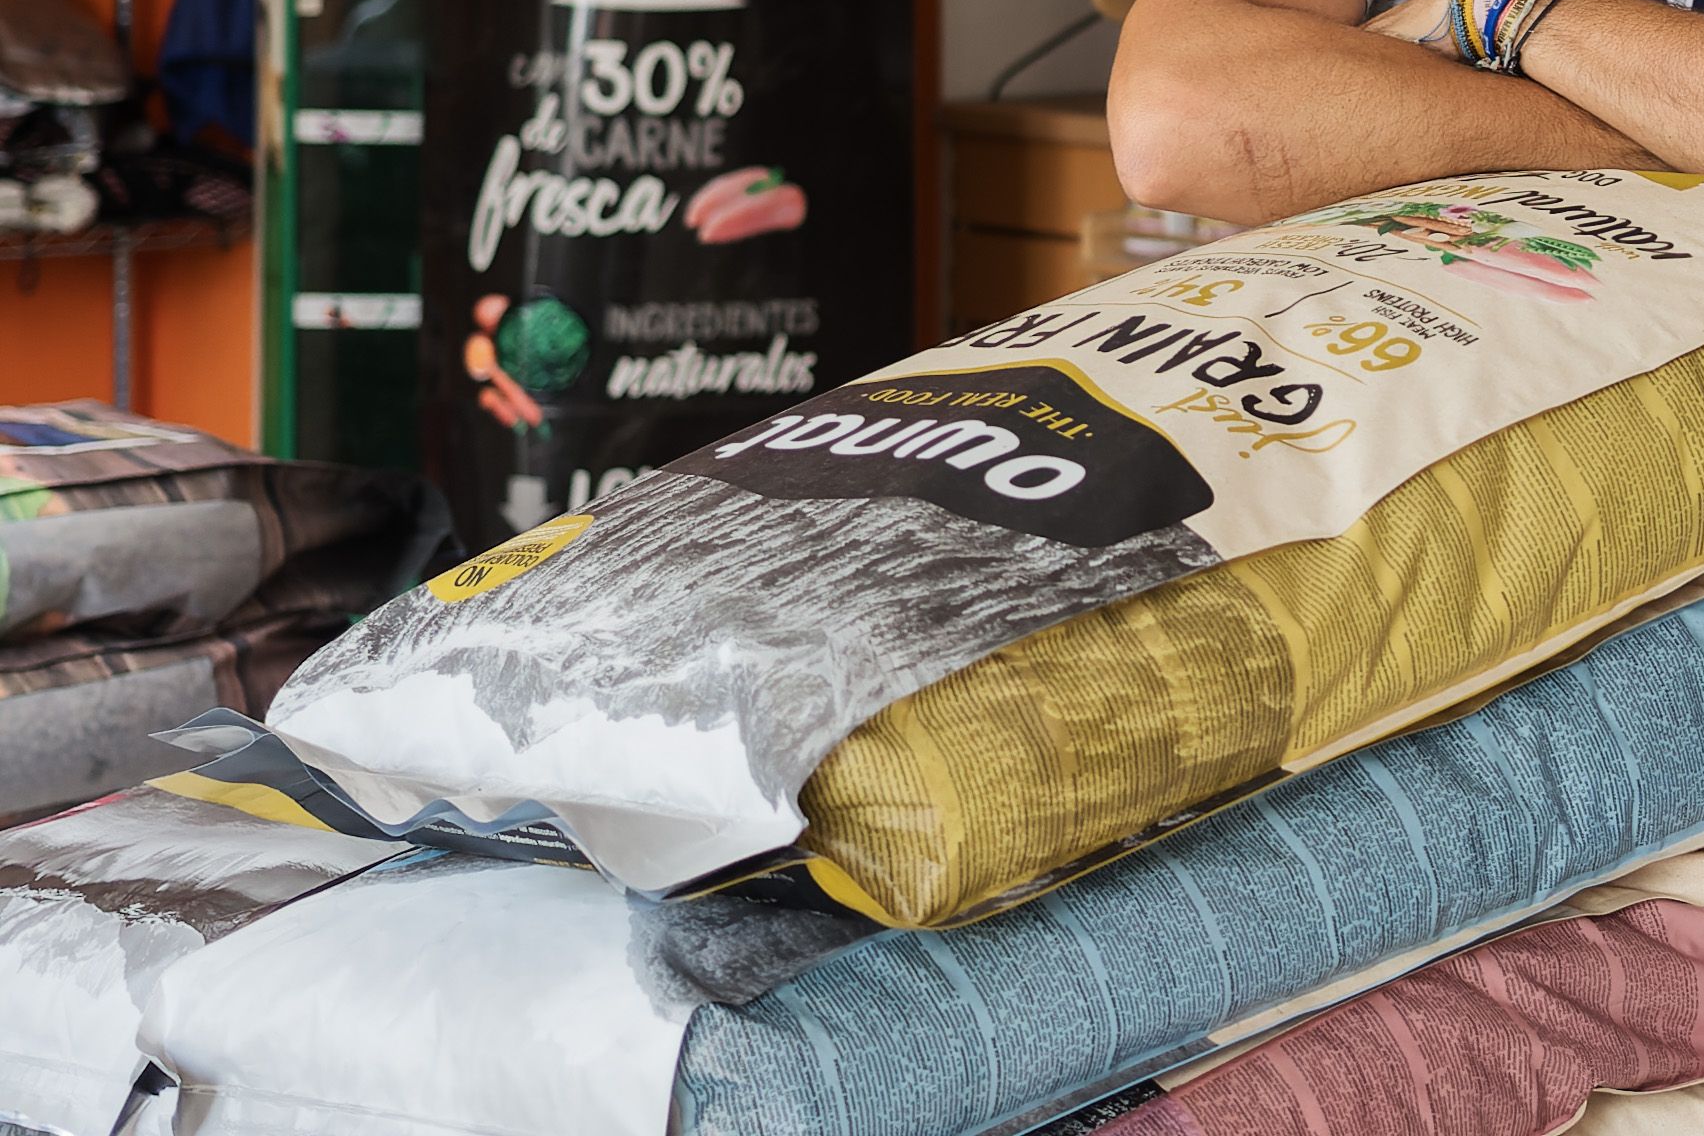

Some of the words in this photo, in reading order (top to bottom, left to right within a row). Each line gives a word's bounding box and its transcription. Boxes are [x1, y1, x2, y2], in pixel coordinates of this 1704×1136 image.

[580, 40, 744, 117] 30%
[575, 117, 728, 170] CARNE
[469, 135, 680, 272] fresca
[1478, 190, 1692, 259] natural
[1293, 262, 1329, 277] LOW
[1363, 289, 1438, 324] PROTEINS
[1303, 316, 1422, 372] 66%
[1433, 322, 1479, 346] HIGH
[607, 333, 817, 399] naturales
[1071, 311, 1323, 425] GRAIN
[868, 387, 943, 405] FOOD
[949, 393, 1031, 409] REAL
[1018, 399, 1083, 440] THE
[714, 413, 1087, 500] ownat
[454, 565, 493, 587] NO
